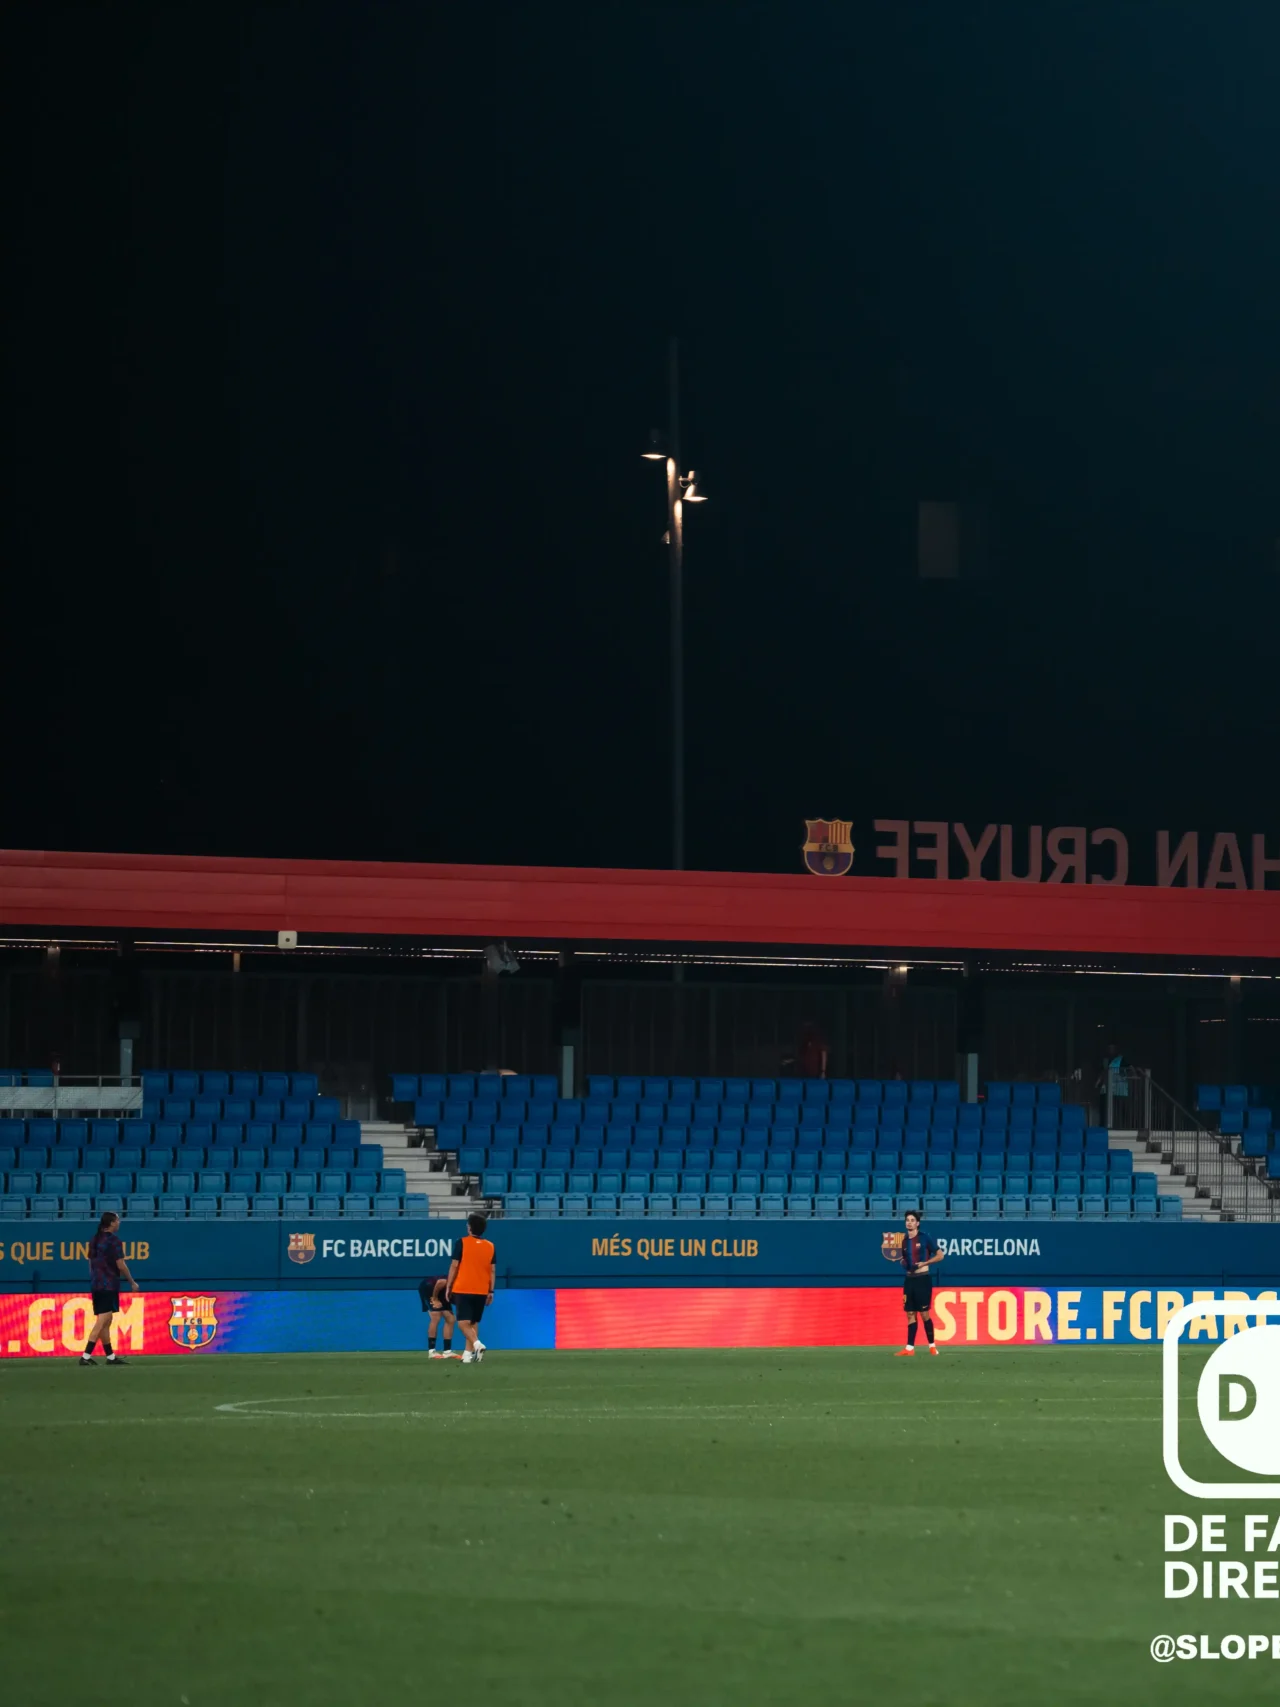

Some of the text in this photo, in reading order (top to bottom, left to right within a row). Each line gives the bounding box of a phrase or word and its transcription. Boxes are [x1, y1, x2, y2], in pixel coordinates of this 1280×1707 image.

[10, 1241, 54, 1264] QUE
[60, 1241, 89, 1260] UN
[322, 1238, 453, 1258] FC BARCELON
[591, 1233, 759, 1260] MÉS QUE UN CLUB
[936, 1238, 1041, 1256] BARCELONA
